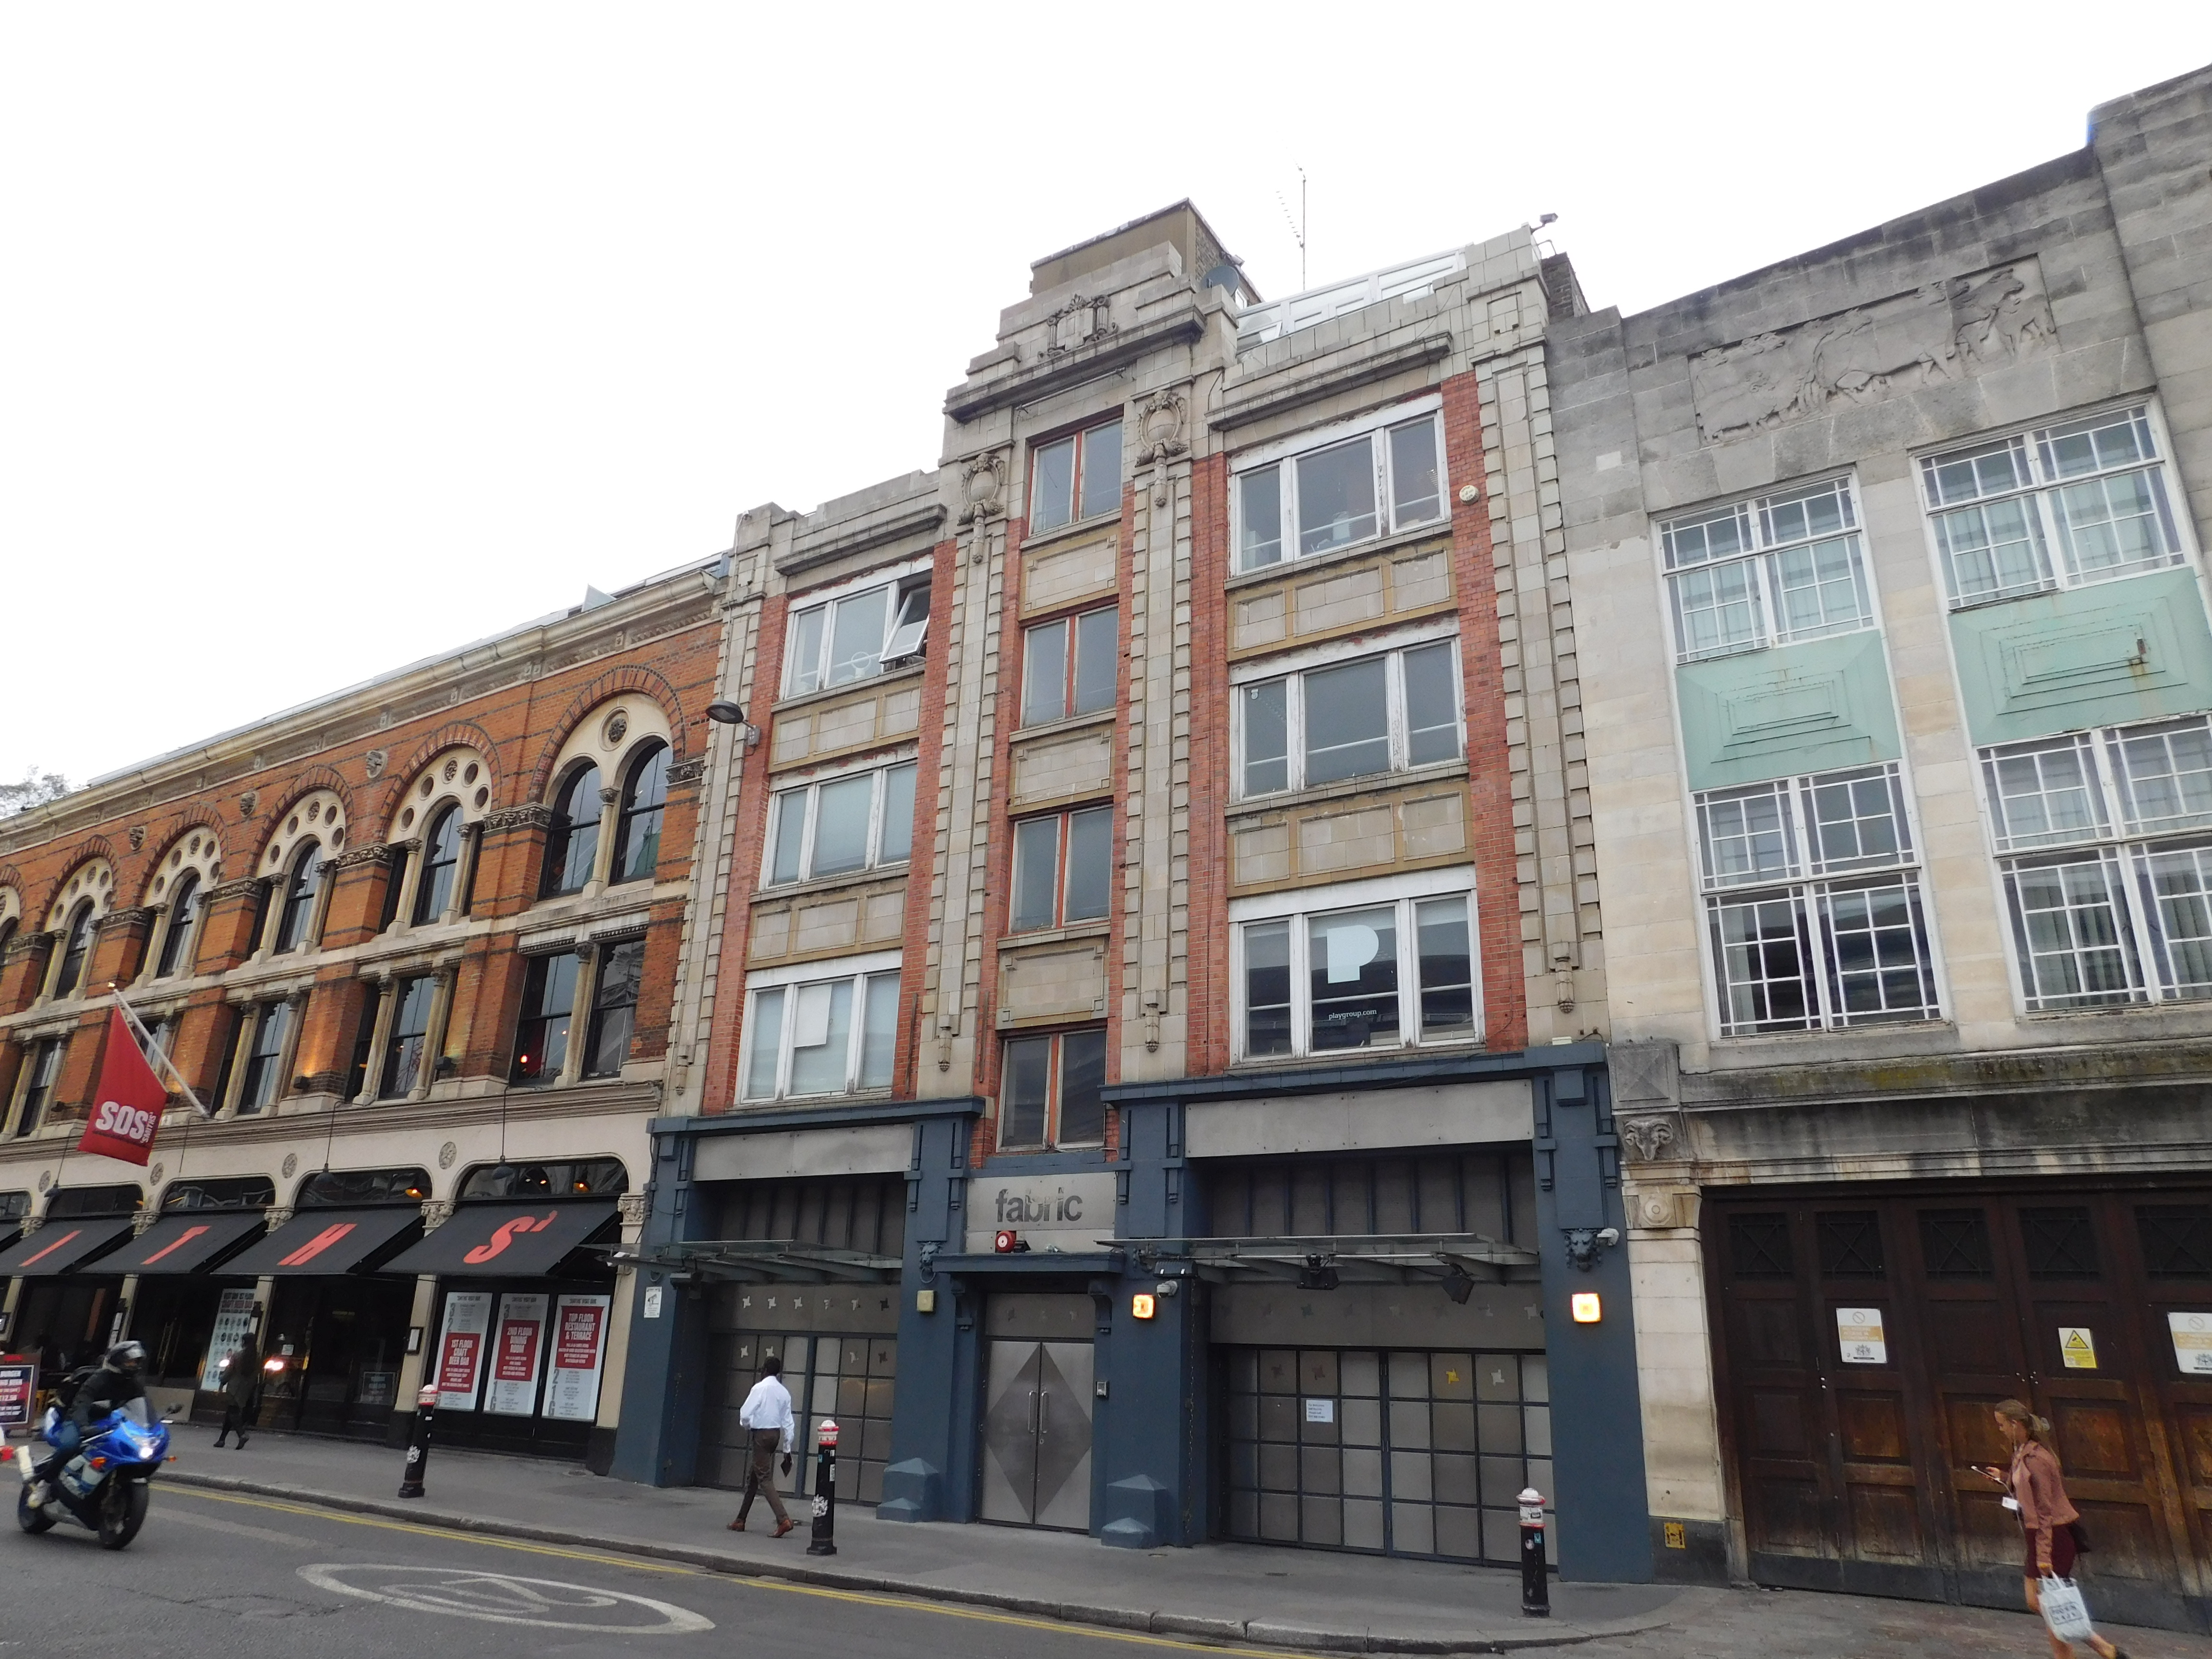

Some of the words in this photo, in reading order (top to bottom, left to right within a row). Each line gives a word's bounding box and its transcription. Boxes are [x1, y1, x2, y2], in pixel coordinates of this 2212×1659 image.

[1327, 925, 1379, 984] P
[1328, 1009, 1377, 1020] playgroup.com
[96, 1101, 149, 1140] SOS
[995, 1187, 1083, 1223] fabric
[568, 1313, 578, 1322] TOP
[578, 1313, 594, 1322] FLOOR
[507, 1326, 518, 1335] 2ND
[518, 1327, 532, 1336] FLOOR
[565, 1322, 596, 1331] RESTAURANT
[565, 1331, 570, 1340] &
[571, 1331, 593, 1340] TERRACE
[459, 1339, 473, 1348] FLOOR
[453, 1347, 468, 1357] CRAFT
